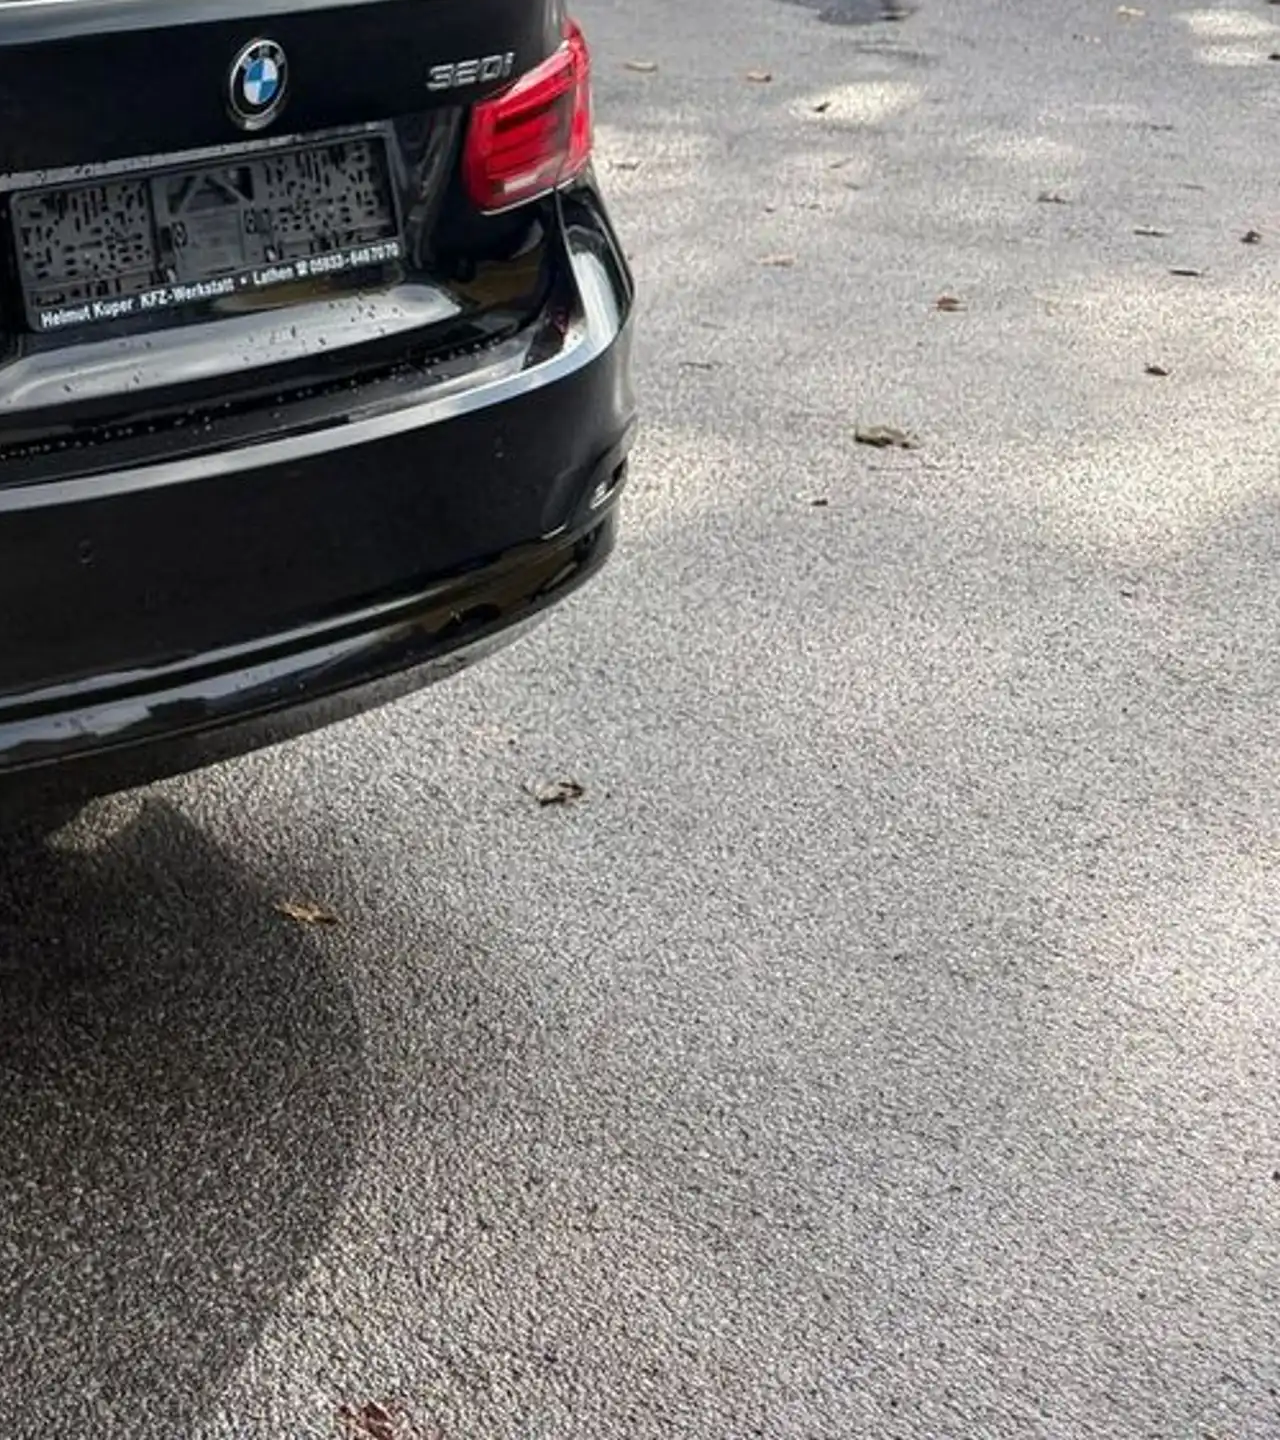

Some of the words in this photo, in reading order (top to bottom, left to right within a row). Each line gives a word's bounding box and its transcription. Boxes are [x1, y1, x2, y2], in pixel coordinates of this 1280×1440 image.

[426, 52, 515, 91] 320i
[41, 305, 91, 329] Helmut
[140, 277, 235, 309] KFZ-Werkstatt
[252, 266, 294, 286] Lathen
